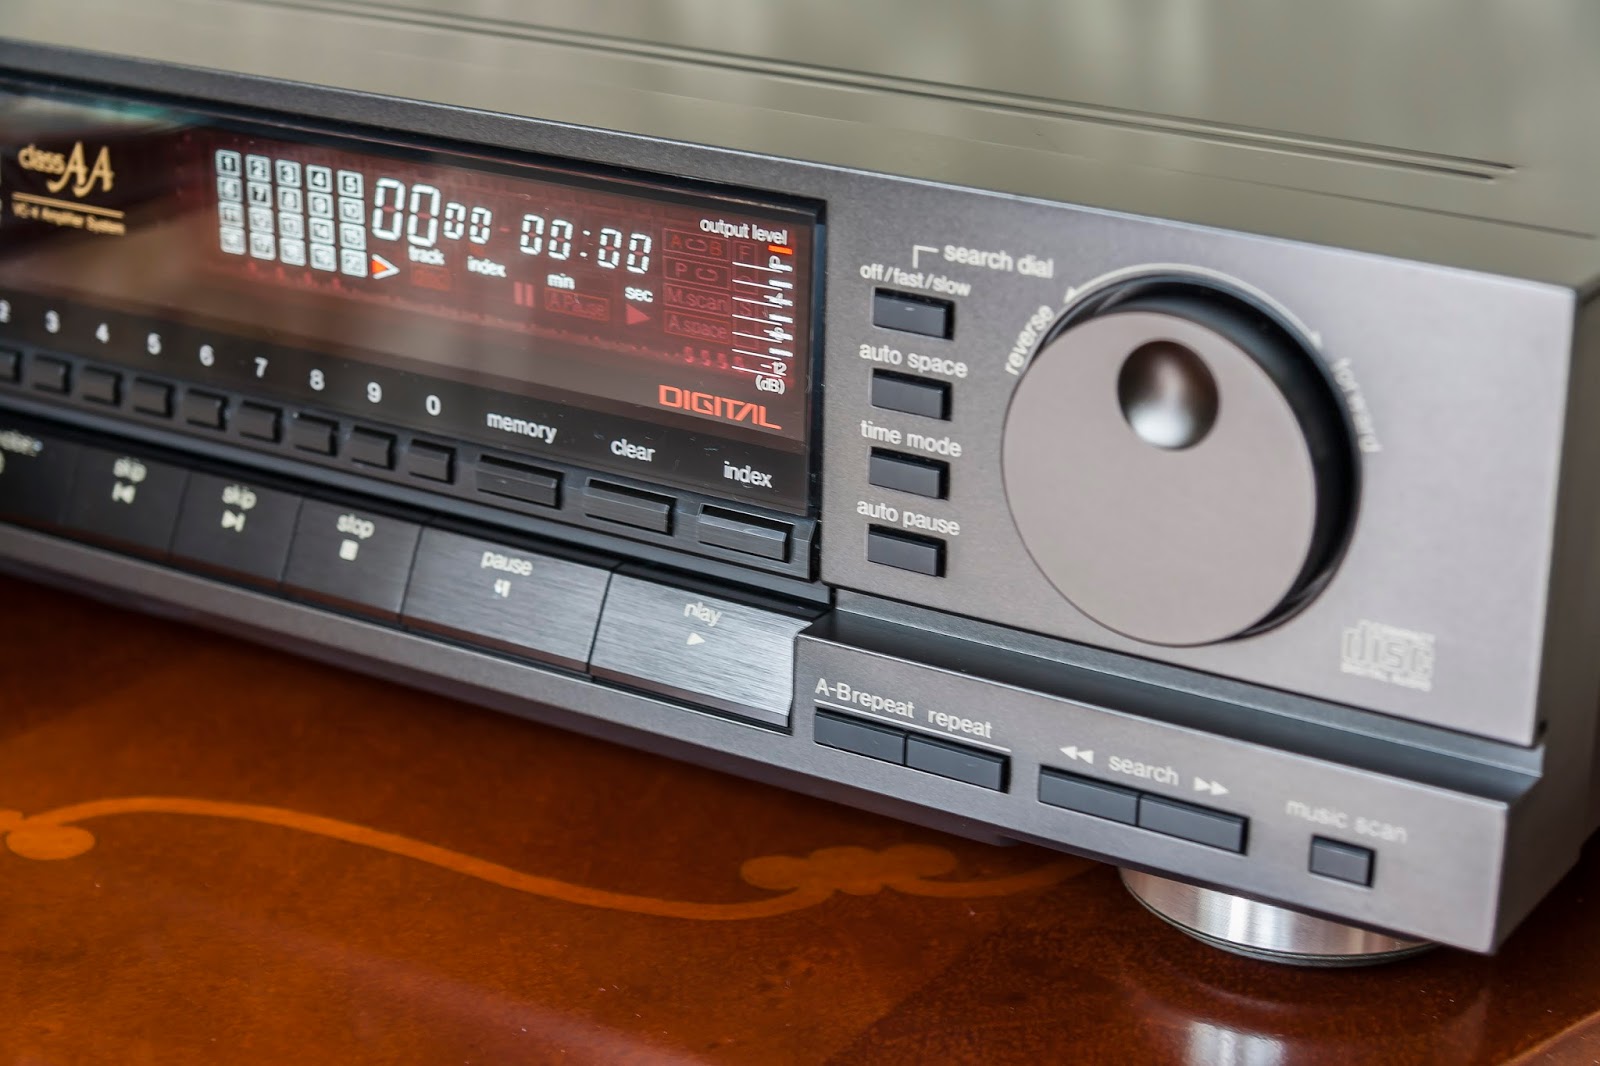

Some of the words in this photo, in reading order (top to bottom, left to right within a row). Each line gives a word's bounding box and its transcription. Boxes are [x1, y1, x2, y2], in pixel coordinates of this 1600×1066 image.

[372, 177, 441, 247] 00
[444, 202, 492, 244] 00
[700, 218, 749, 239] output
[752, 224, 788, 246] level
[467, 255, 507, 277] index
[675, 262, 687, 277] P
[943, 244, 1013, 271] search
[1017, 256, 1054, 279] dial
[547, 273, 575, 290] min
[625, 286, 653, 303] sec
[45, 310, 60, 333] 3
[96, 323, 109, 343] 4
[147, 332, 161, 355] 5
[1005, 305, 1054, 376] reverse
[200, 344, 215, 367] 6
[254, 356, 268, 378] 7
[859, 343, 902, 365] auto
[907, 352, 968, 379] space
[310, 369, 325, 391] 8
[367, 382, 382, 403] 9
[756, 375, 785, 394] (dB)
[425, 395, 441, 416] 0
[658, 384, 782, 430] DIGITAL
[487, 412, 557, 444] memory
[861, 420, 901, 445] time
[907, 433, 962, 457] mode
[611, 438, 655, 463] clear
[724, 461, 773, 489] index
[336, 513, 375, 540] stop
[857, 500, 899, 523] auto
[903, 511, 960, 536] pause
[481, 551, 533, 576] pause
[928, 708, 993, 739] repeat
[1108, 754, 1179, 787] search
[1284, 800, 1348, 829] music
[1354, 817, 1408, 844] scan
